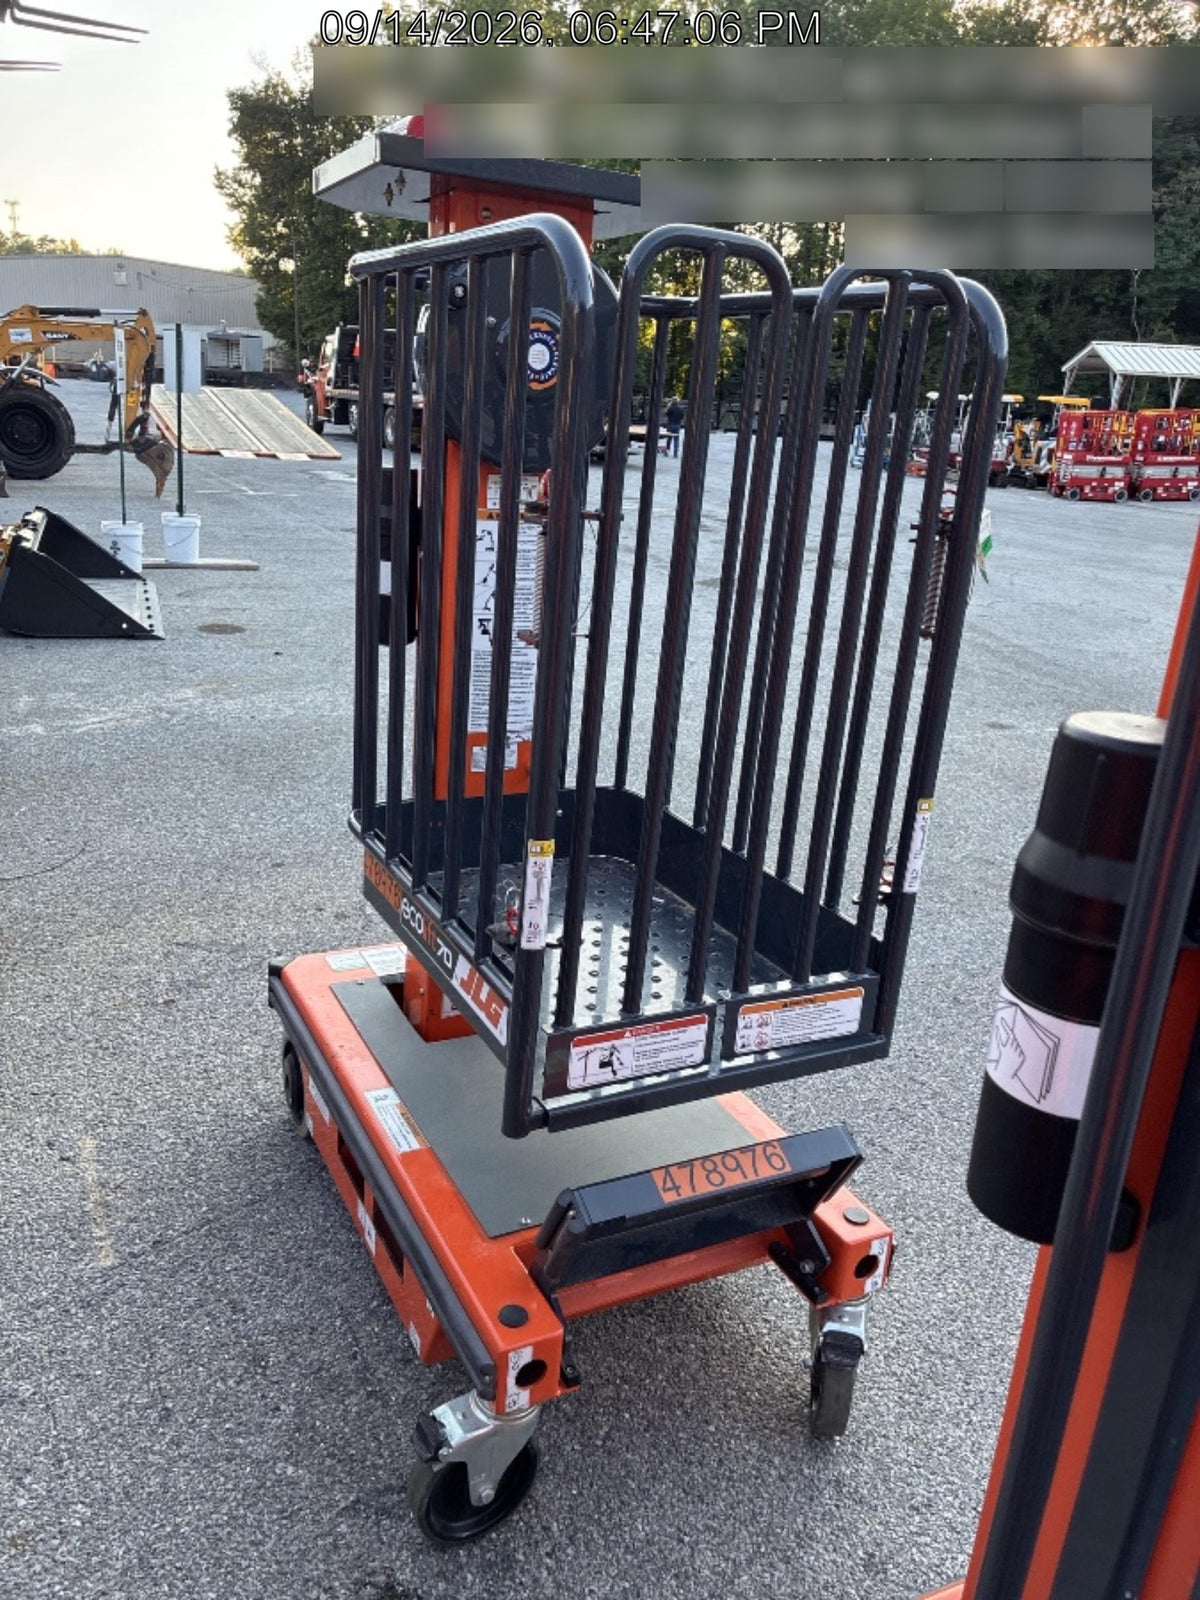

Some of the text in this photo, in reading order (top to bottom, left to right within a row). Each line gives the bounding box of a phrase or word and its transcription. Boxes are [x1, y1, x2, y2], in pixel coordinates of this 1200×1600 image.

[437, 938, 453, 969] 70
[460, 967, 504, 1029] JLG
[662, 1143, 787, 1197] 478976
